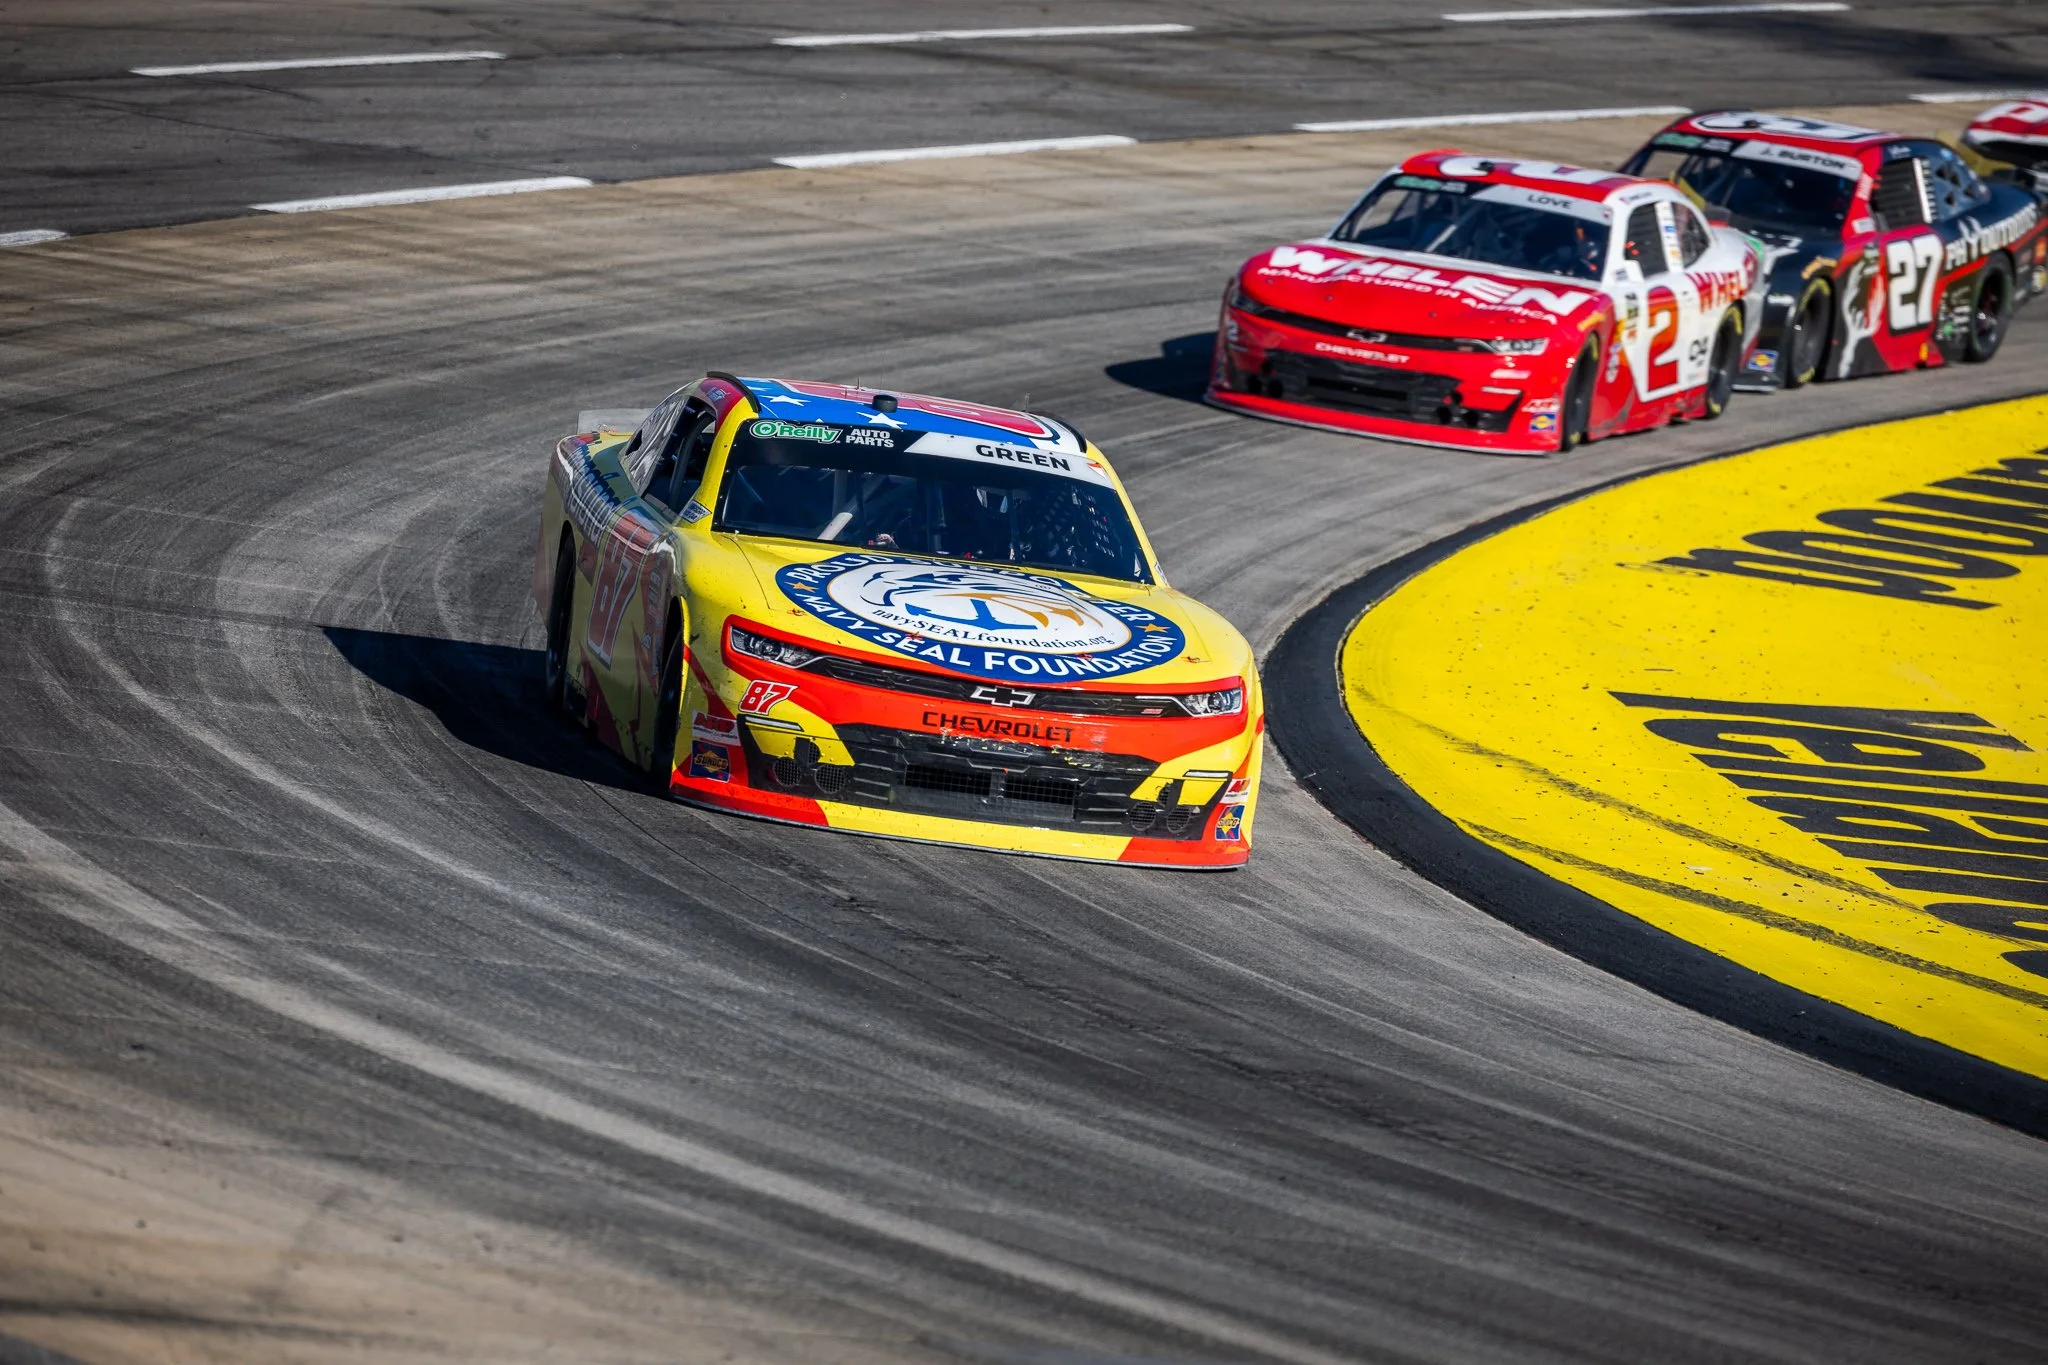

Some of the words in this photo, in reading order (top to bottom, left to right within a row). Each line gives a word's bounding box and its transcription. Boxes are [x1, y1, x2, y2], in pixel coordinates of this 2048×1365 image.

[1778, 150, 1845, 169] BURTON
[1527, 193, 1573, 210] LOVE
[1268, 245, 1595, 317] WHELEN
[1886, 233, 1944, 331] 27
[1646, 285, 1680, 393] 2
[754, 421, 841, 443] O'Reilly
[850, 428, 891, 439] AUTO
[845, 435, 895, 448] PARTS
[975, 443, 1071, 472] GREEN
[786, 554, 895, 584] PROUD
[796, 593, 880, 631] NAVY
[872, 631, 972, 667] SEAL
[983, 634, 1179, 677] FOUNDATION
[739, 680, 799, 716] 87
[922, 710, 1075, 743] CHEVROLET
